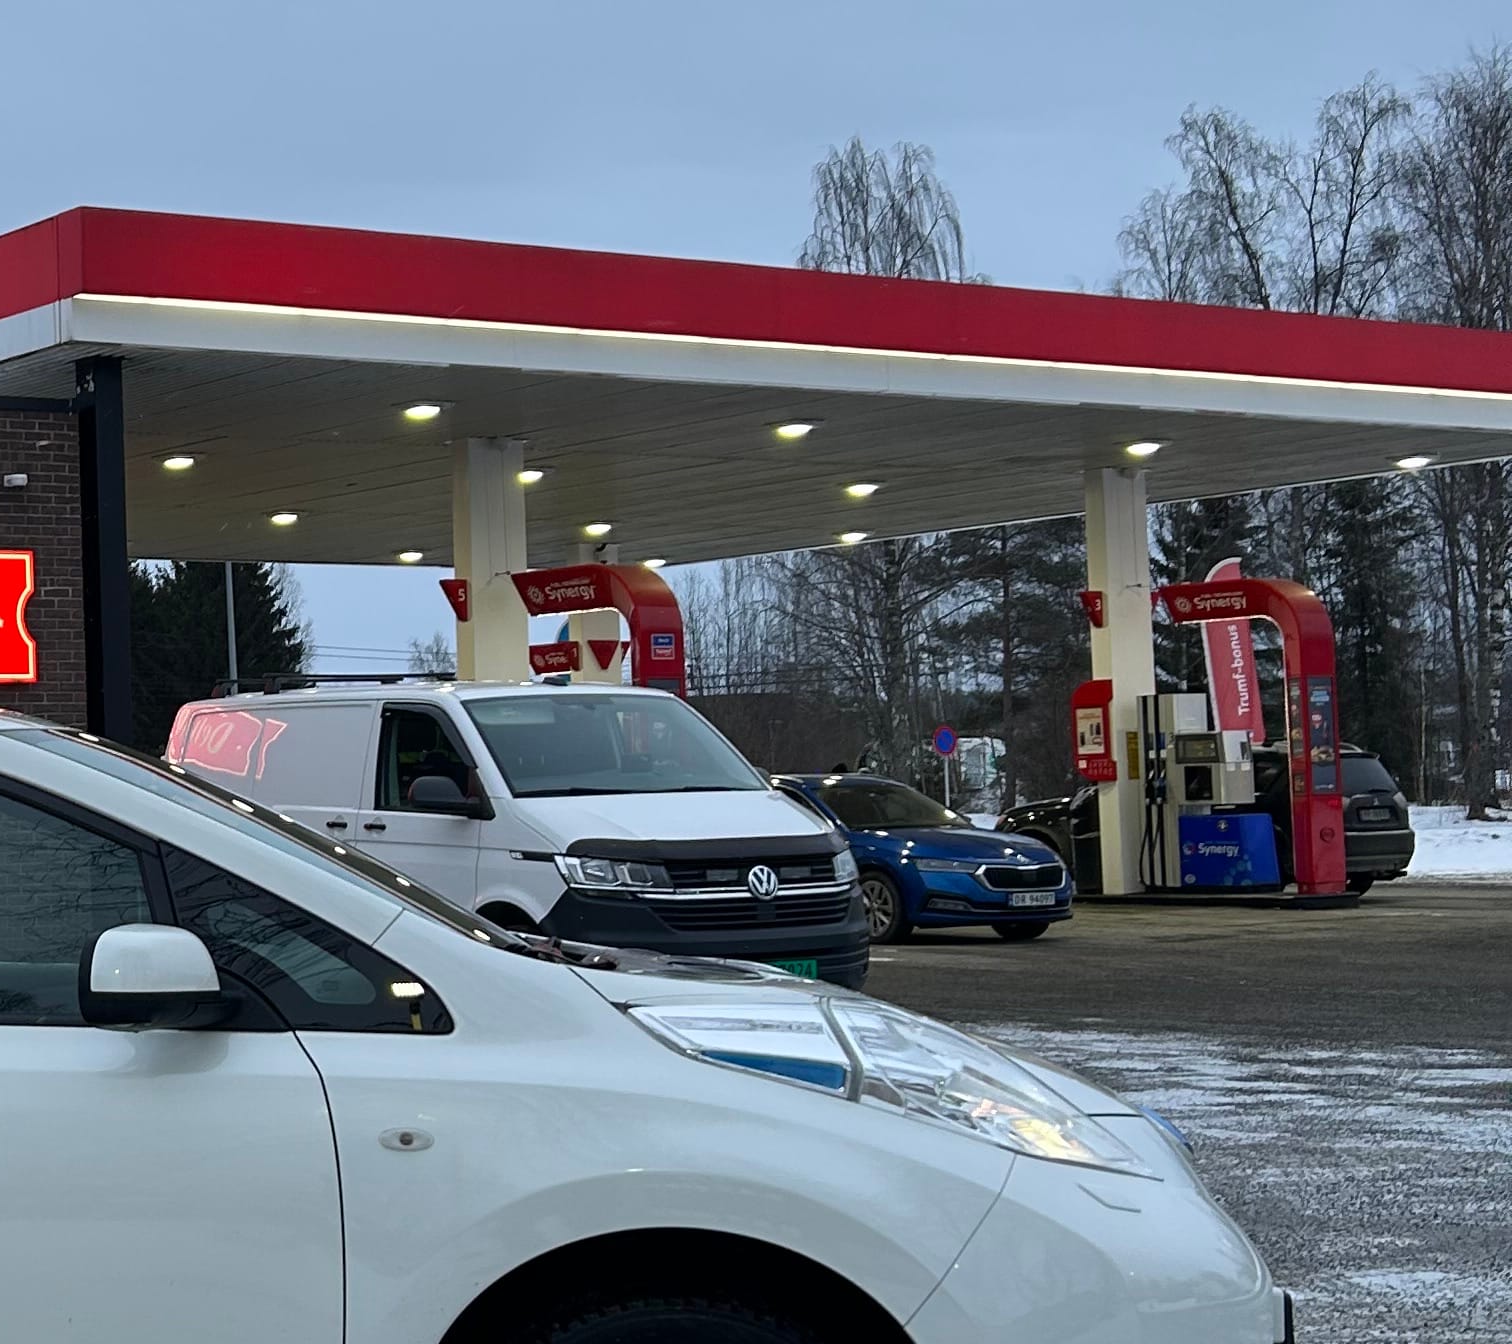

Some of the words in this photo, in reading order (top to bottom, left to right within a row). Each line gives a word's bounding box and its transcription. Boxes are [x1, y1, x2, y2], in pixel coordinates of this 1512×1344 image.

[458, 589, 465, 601] 5
[544, 585, 596, 602] Synergy
[1095, 599, 1101, 611] 3
[1193, 596, 1247, 611] Synergy
[1228, 624, 1250, 716] Trumf-bonus
[1198, 842, 1240, 857] Synergy
